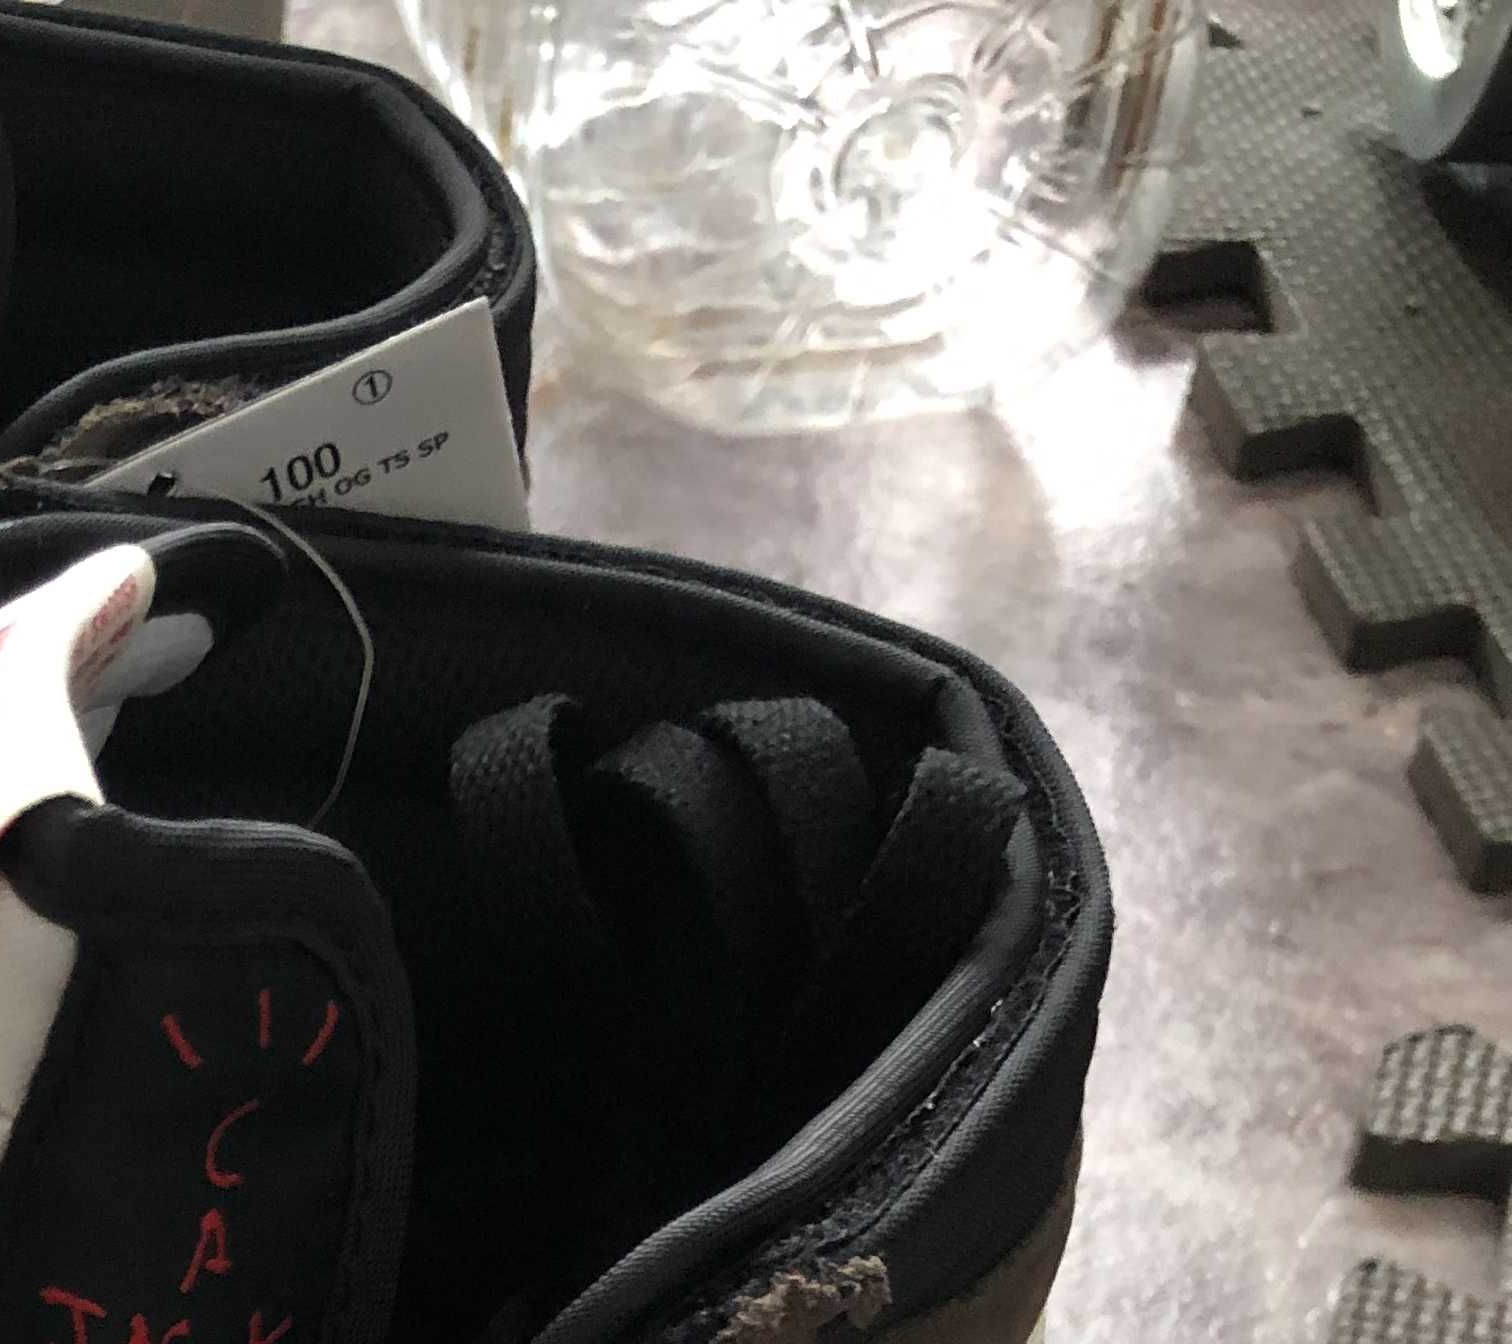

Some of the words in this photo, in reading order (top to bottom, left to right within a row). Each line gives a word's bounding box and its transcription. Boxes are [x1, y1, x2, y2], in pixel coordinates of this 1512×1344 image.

[260, 442, 341, 502] 100
[334, 467, 372, 497] OG
[376, 449, 411, 475] TS
[417, 430, 449, 458] SP
